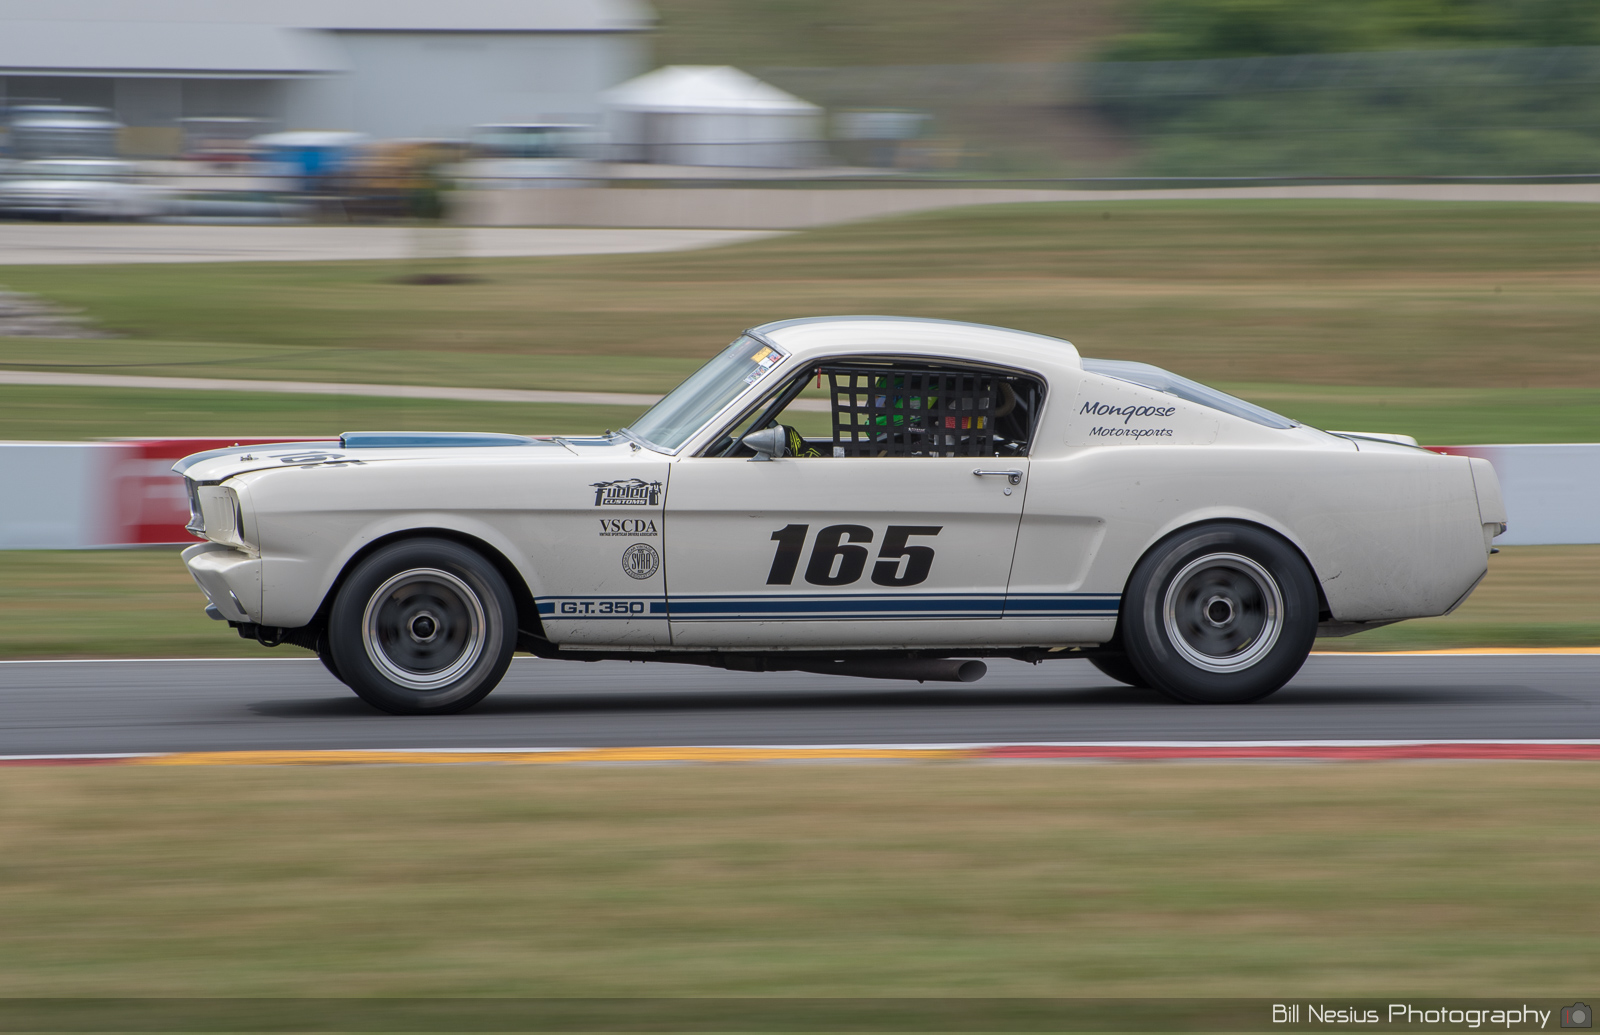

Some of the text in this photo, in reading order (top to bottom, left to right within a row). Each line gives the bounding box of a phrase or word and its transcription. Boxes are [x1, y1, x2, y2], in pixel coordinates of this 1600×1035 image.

[1080, 401, 1176, 425] Mongoose
[1089, 427, 1174, 440] Motorsports
[600, 519, 658, 532] VSCDA
[631, 553, 651, 570] SVRA
[766, 524, 944, 587] 165
[561, 601, 645, 614] G.T. 350
